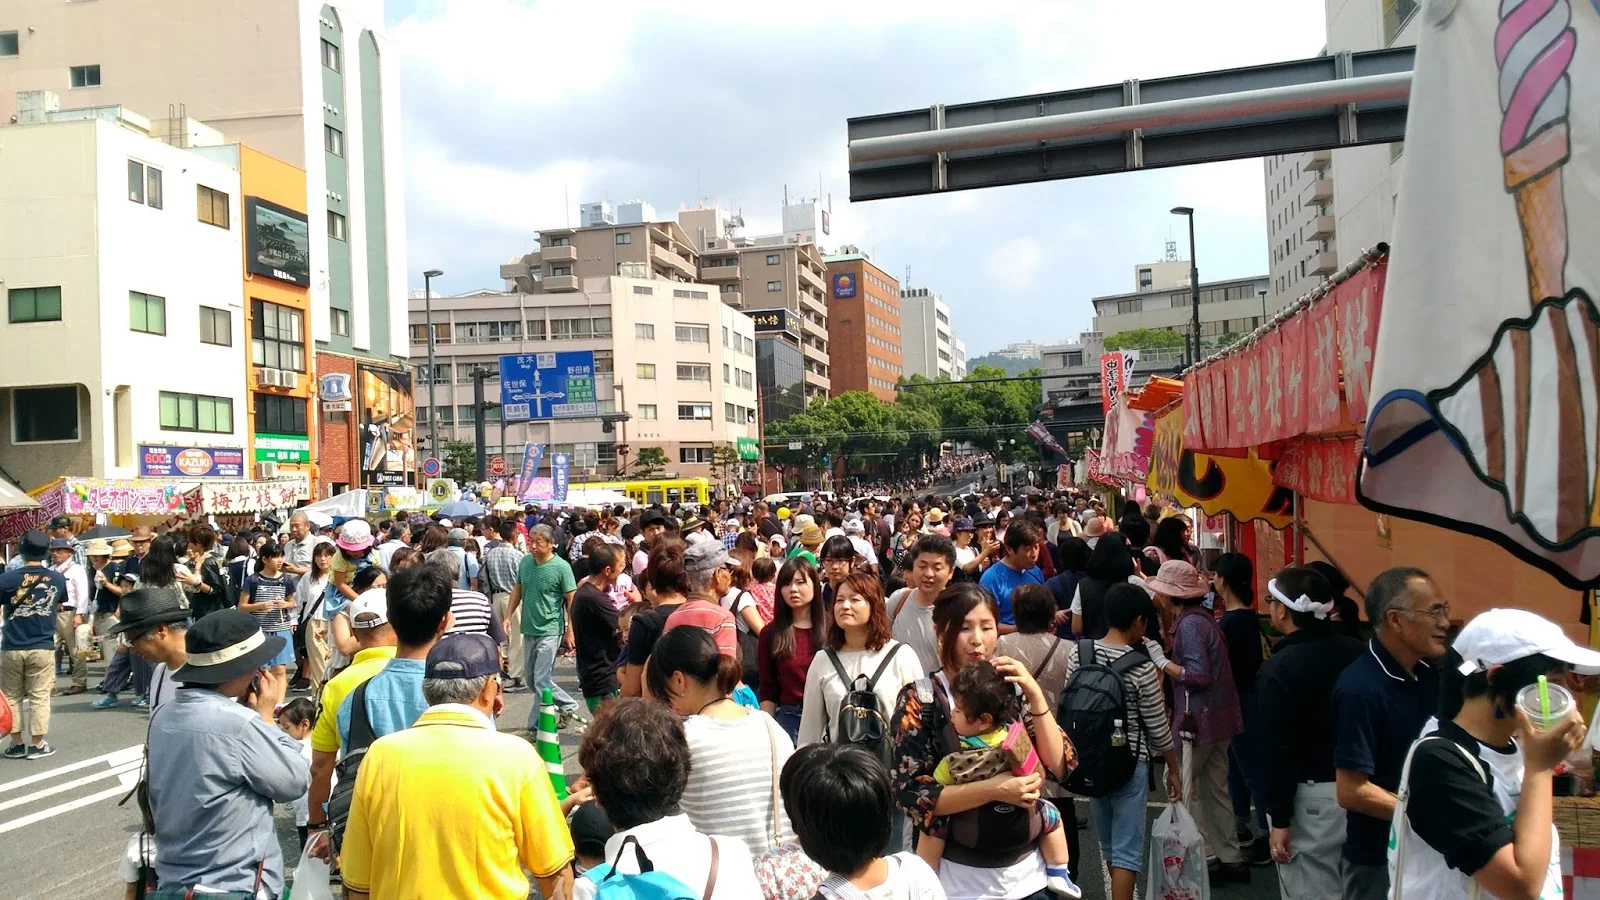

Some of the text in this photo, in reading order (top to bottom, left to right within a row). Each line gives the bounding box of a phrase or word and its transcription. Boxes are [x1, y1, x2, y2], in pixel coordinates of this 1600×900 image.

[516, 356, 534, 364] 茂木
[503, 380, 527, 389] 佐世保
[506, 405, 529, 413] 長崎駅
[179, 457, 210, 467] KAZUKI
[22, 573, 51, 587] Japn
